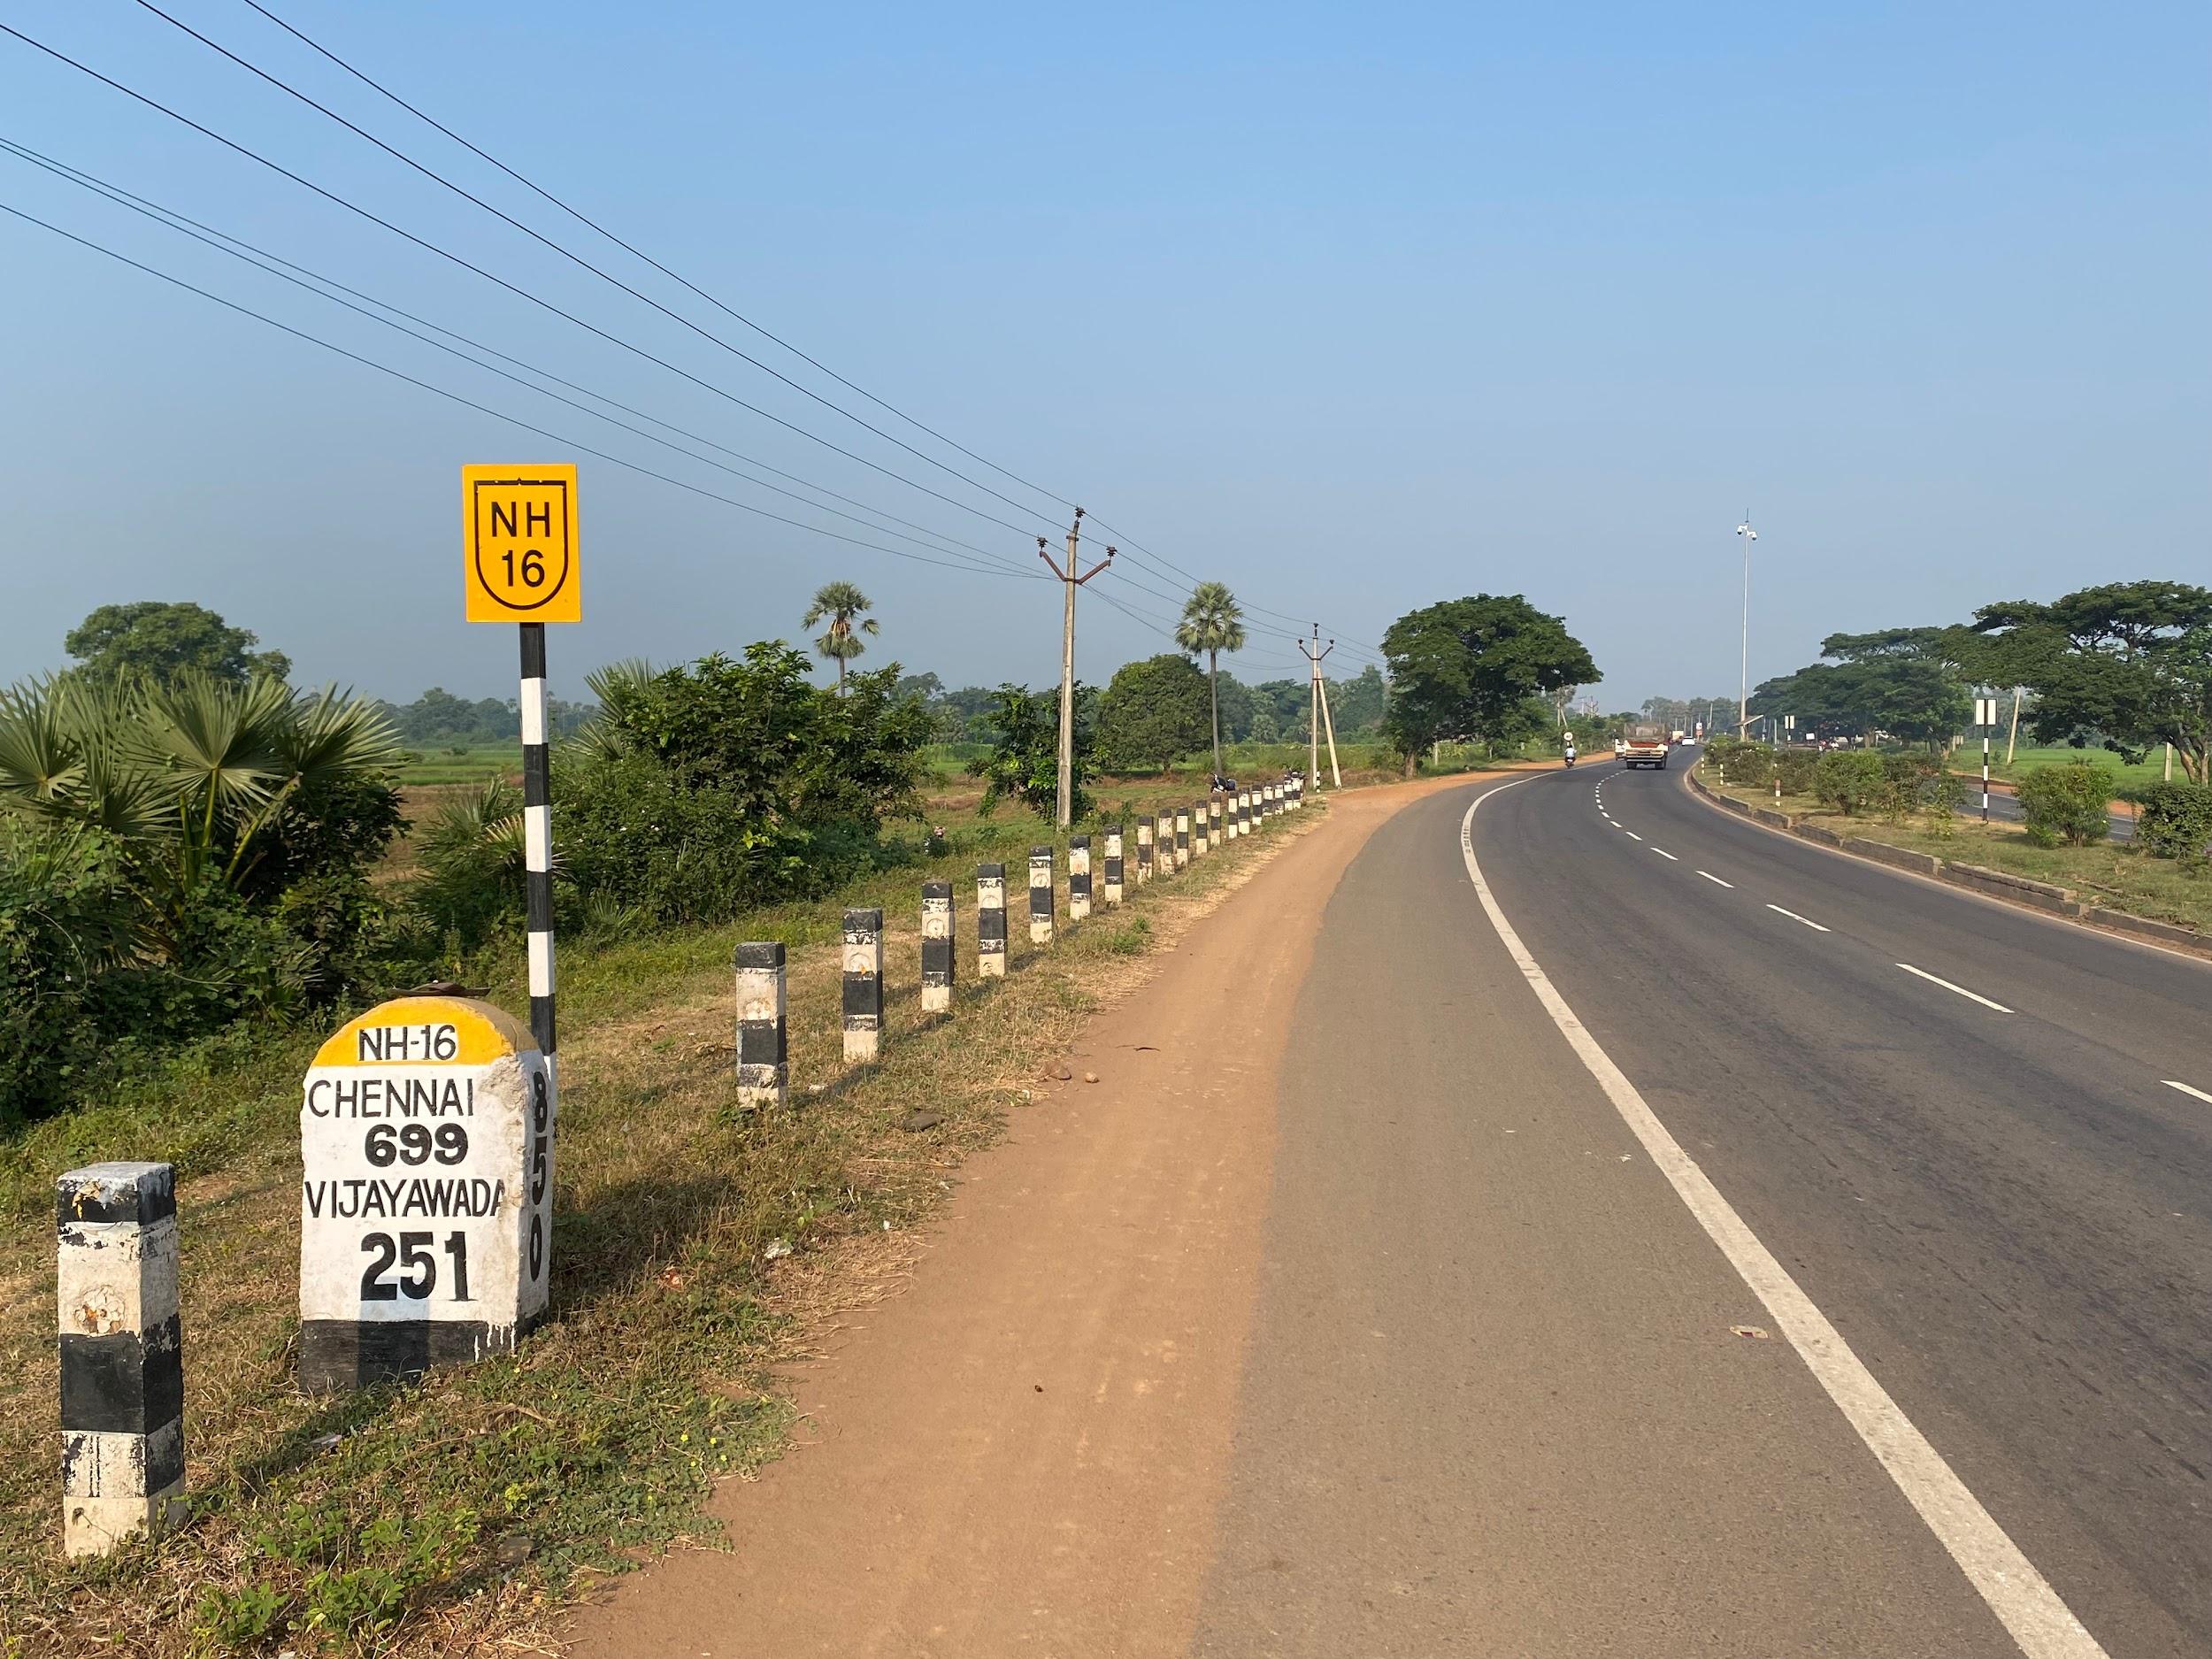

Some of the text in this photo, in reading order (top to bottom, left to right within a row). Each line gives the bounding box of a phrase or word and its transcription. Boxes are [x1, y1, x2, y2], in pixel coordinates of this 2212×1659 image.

[491, 501, 550, 538] NH
[502, 549, 545, 588] 16
[359, 1025, 457, 1061] NH-16
[308, 1079, 474, 1118] CHENNAI
[365, 1123, 469, 1167] 699
[304, 1179, 505, 1218] VIJAYAWADA
[360, 1231, 471, 1302] 251
